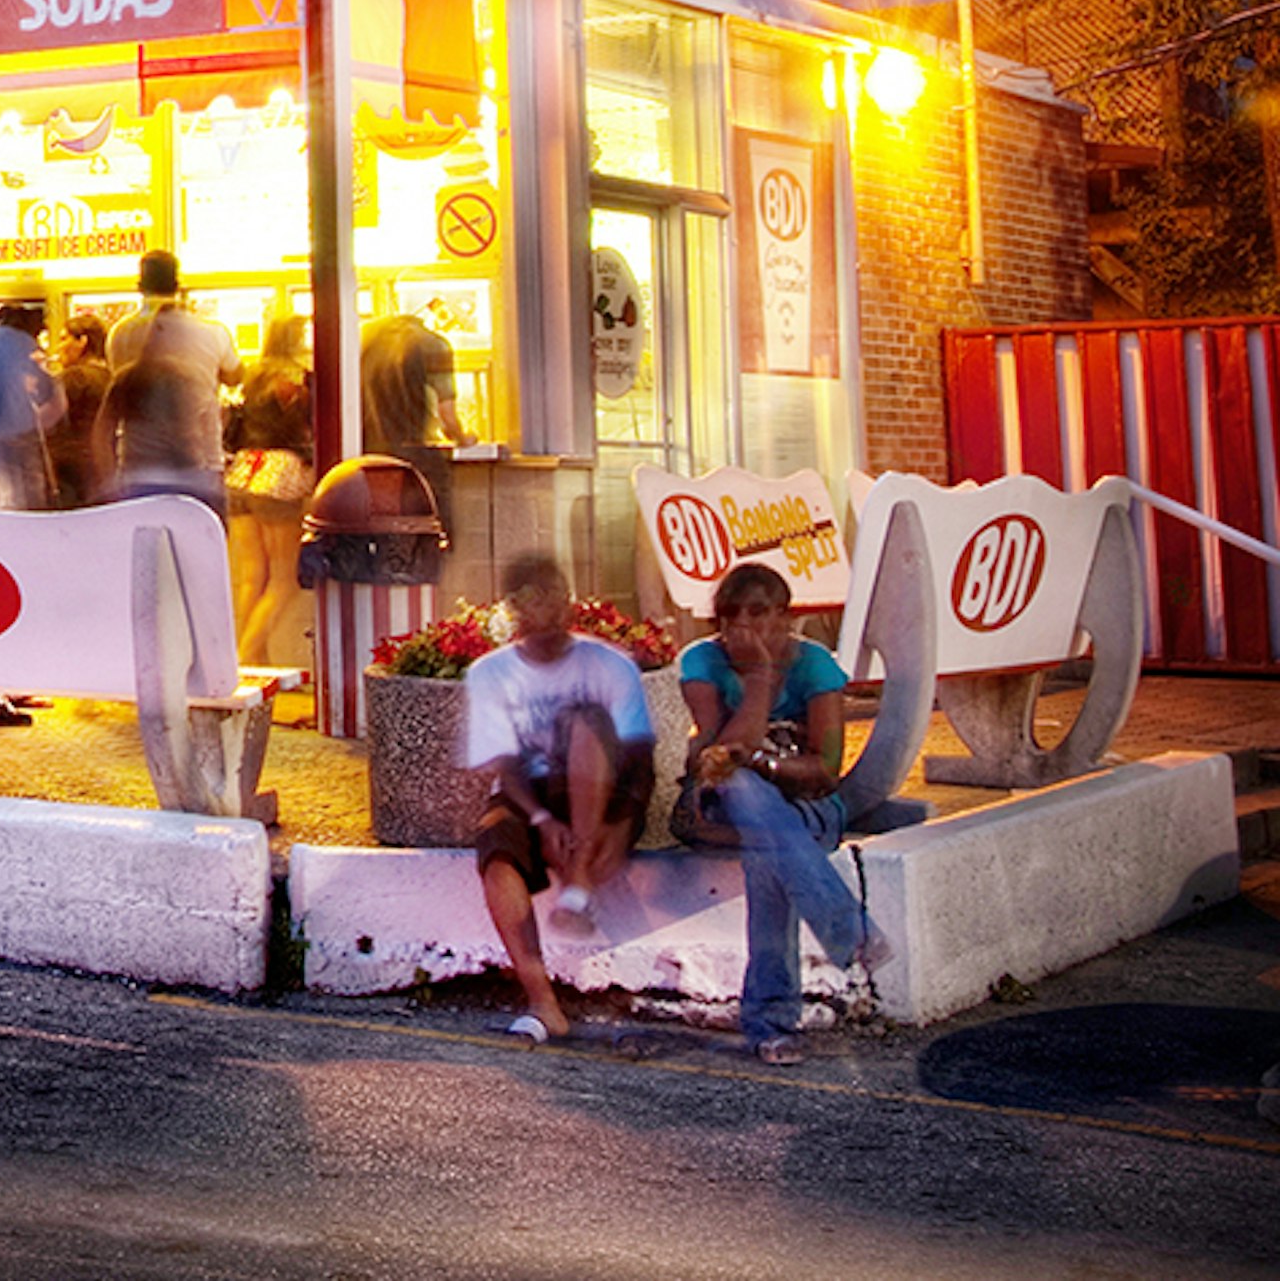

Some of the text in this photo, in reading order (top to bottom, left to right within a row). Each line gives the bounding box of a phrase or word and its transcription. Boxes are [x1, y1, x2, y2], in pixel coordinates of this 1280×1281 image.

[764, 175, 803, 237] BDI
[13, 238, 51, 260] SOFT
[56, 235, 82, 257] ICE
[86, 231, 147, 255] CREAM
[661, 498, 726, 577] BDI
[720, 495, 813, 550] BANANA
[781, 527, 839, 582] SPLIT
[959, 521, 1040, 625] BDI
